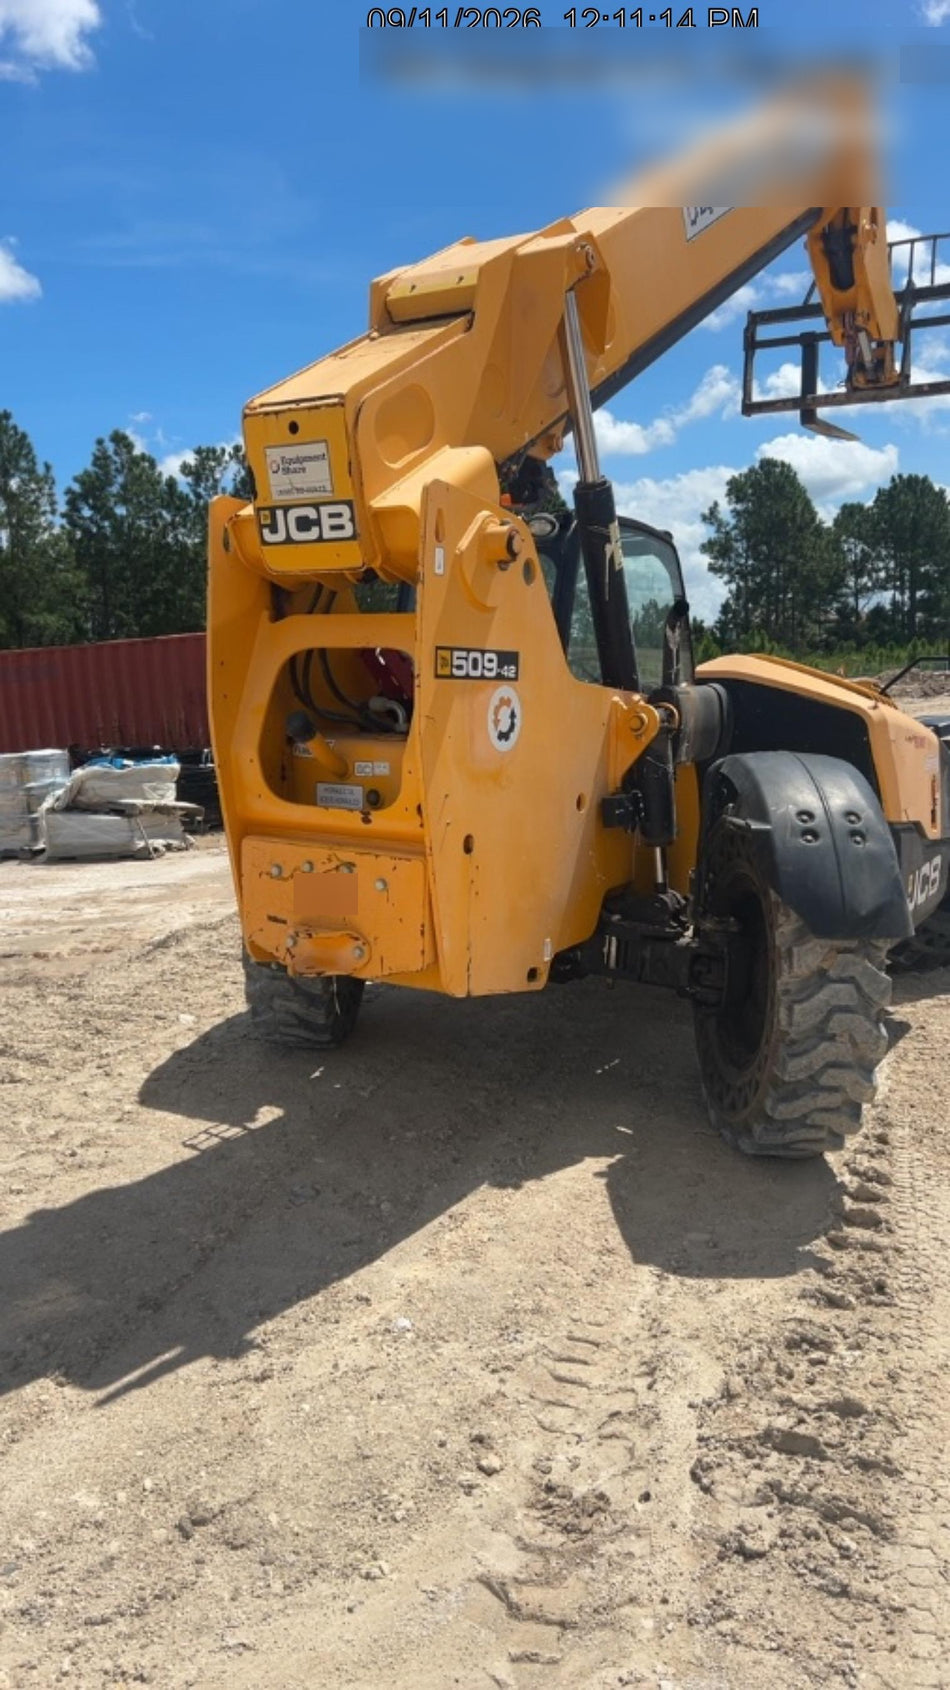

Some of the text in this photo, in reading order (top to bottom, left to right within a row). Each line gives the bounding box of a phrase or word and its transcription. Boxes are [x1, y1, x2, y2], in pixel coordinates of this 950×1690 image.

[281, 453, 326, 466] Equipment
[281, 466, 307, 475] Share
[262, 504, 354, 543] JCB
[451, 651, 517, 677] 509-42
[907, 855, 941, 910] JCB
